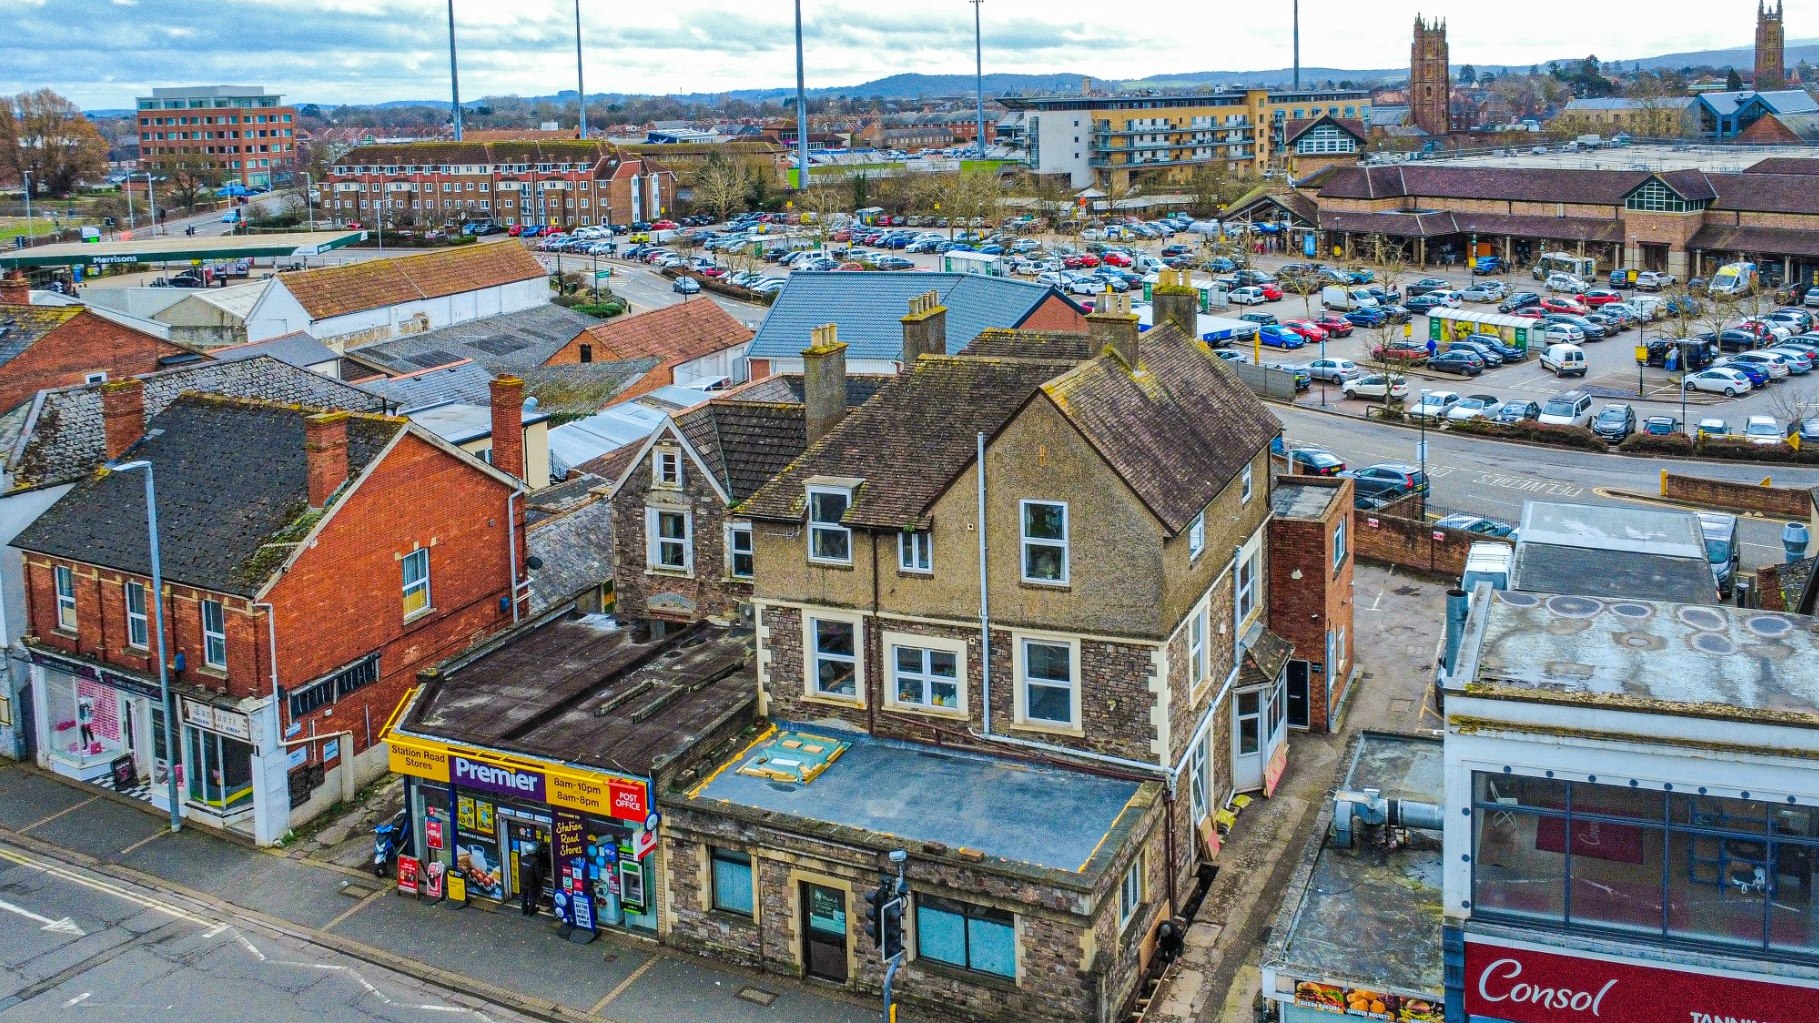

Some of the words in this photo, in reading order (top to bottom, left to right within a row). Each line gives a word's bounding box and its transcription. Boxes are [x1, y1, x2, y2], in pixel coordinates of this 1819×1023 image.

[93, 255, 137, 264] Morrisons
[392, 745, 421, 758] Station
[423, 751, 445, 763] Road
[405, 757, 433, 770] Stores
[455, 756, 538, 792] Premier
[619, 791, 638, 802] POST
[615, 798, 641, 811] OFFICE
[556, 820, 583, 834] Station
[560, 832, 580, 844] Road
[560, 844, 582, 856] Stores
[1478, 958, 1619, 1017] Consol
[1346, 1008, 1368, 1017] CHICKEN
